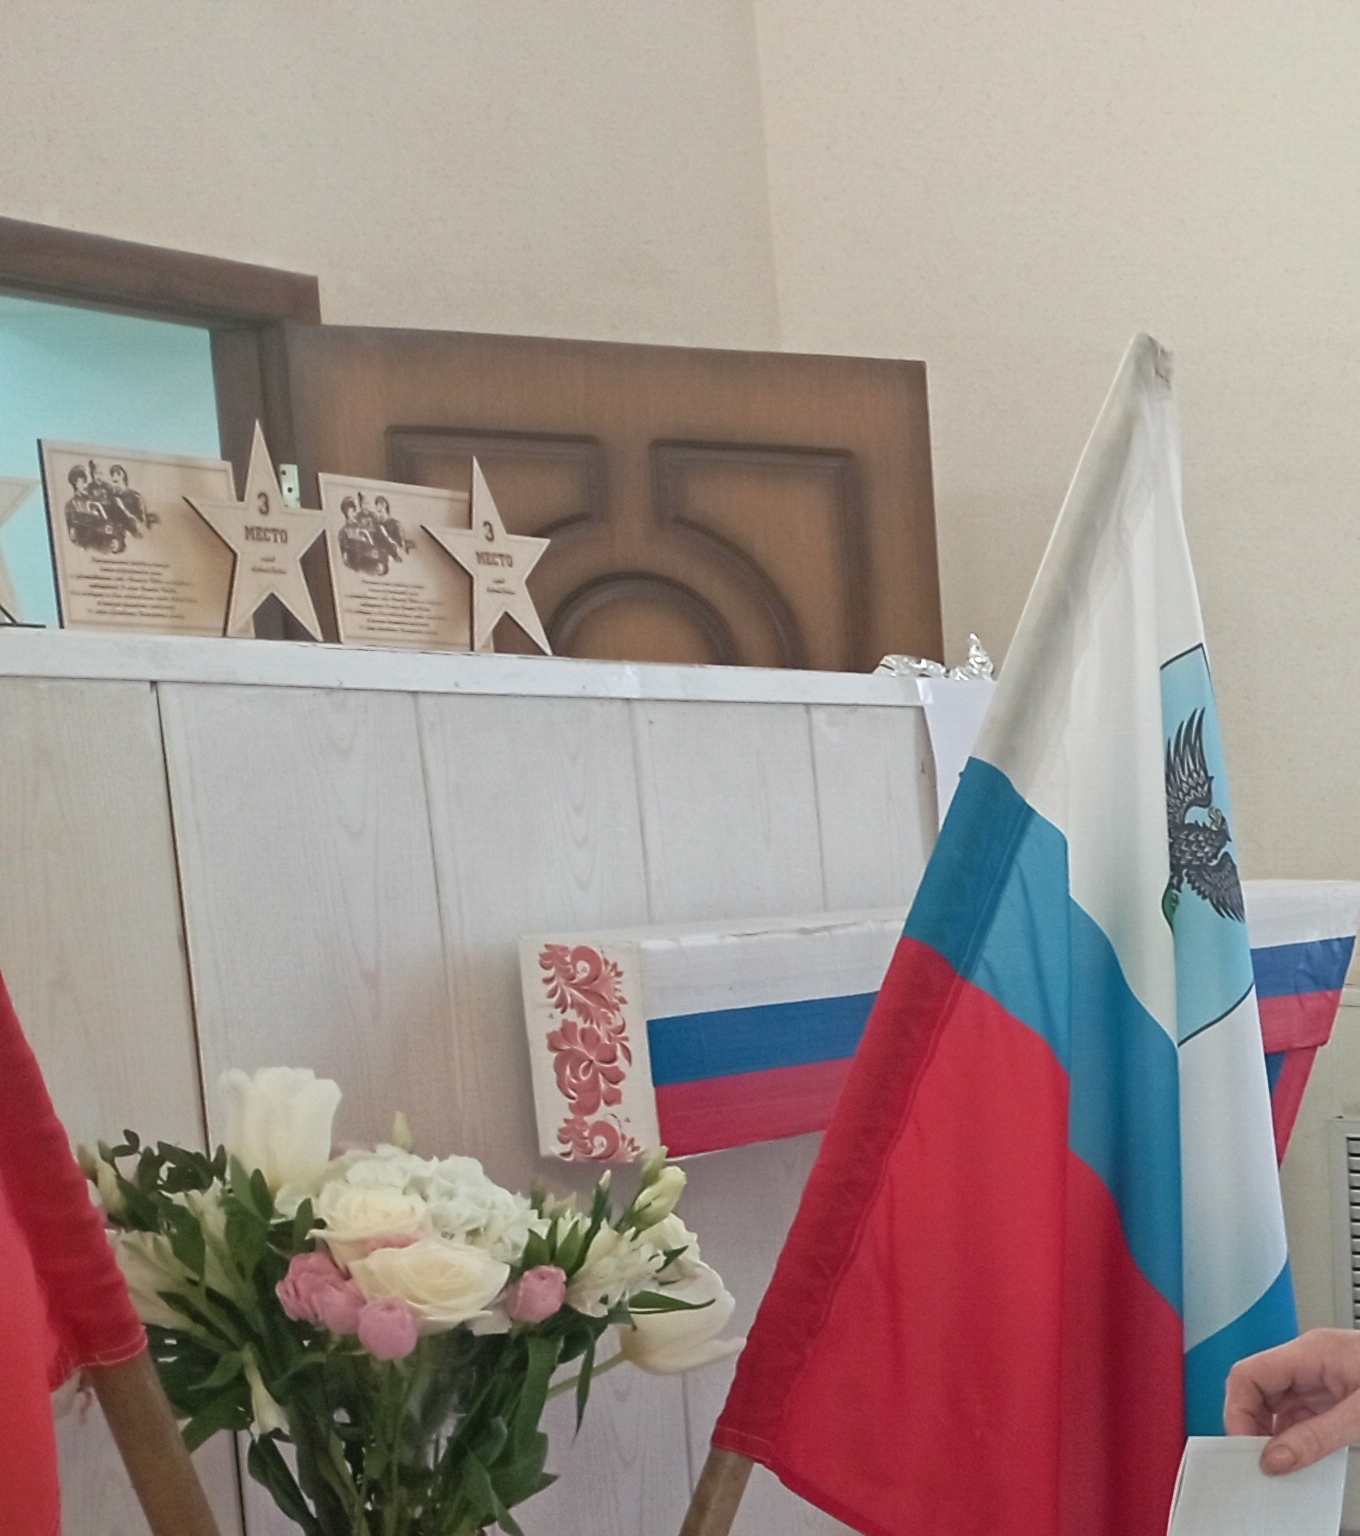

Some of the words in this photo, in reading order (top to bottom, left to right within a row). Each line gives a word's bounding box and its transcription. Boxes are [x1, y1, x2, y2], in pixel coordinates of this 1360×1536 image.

[257, 491, 270, 515] 3
[244, 525, 288, 543] МЕСТО
[483, 521, 495, 542] 3
[475, 551, 513, 568] МЕСТО
